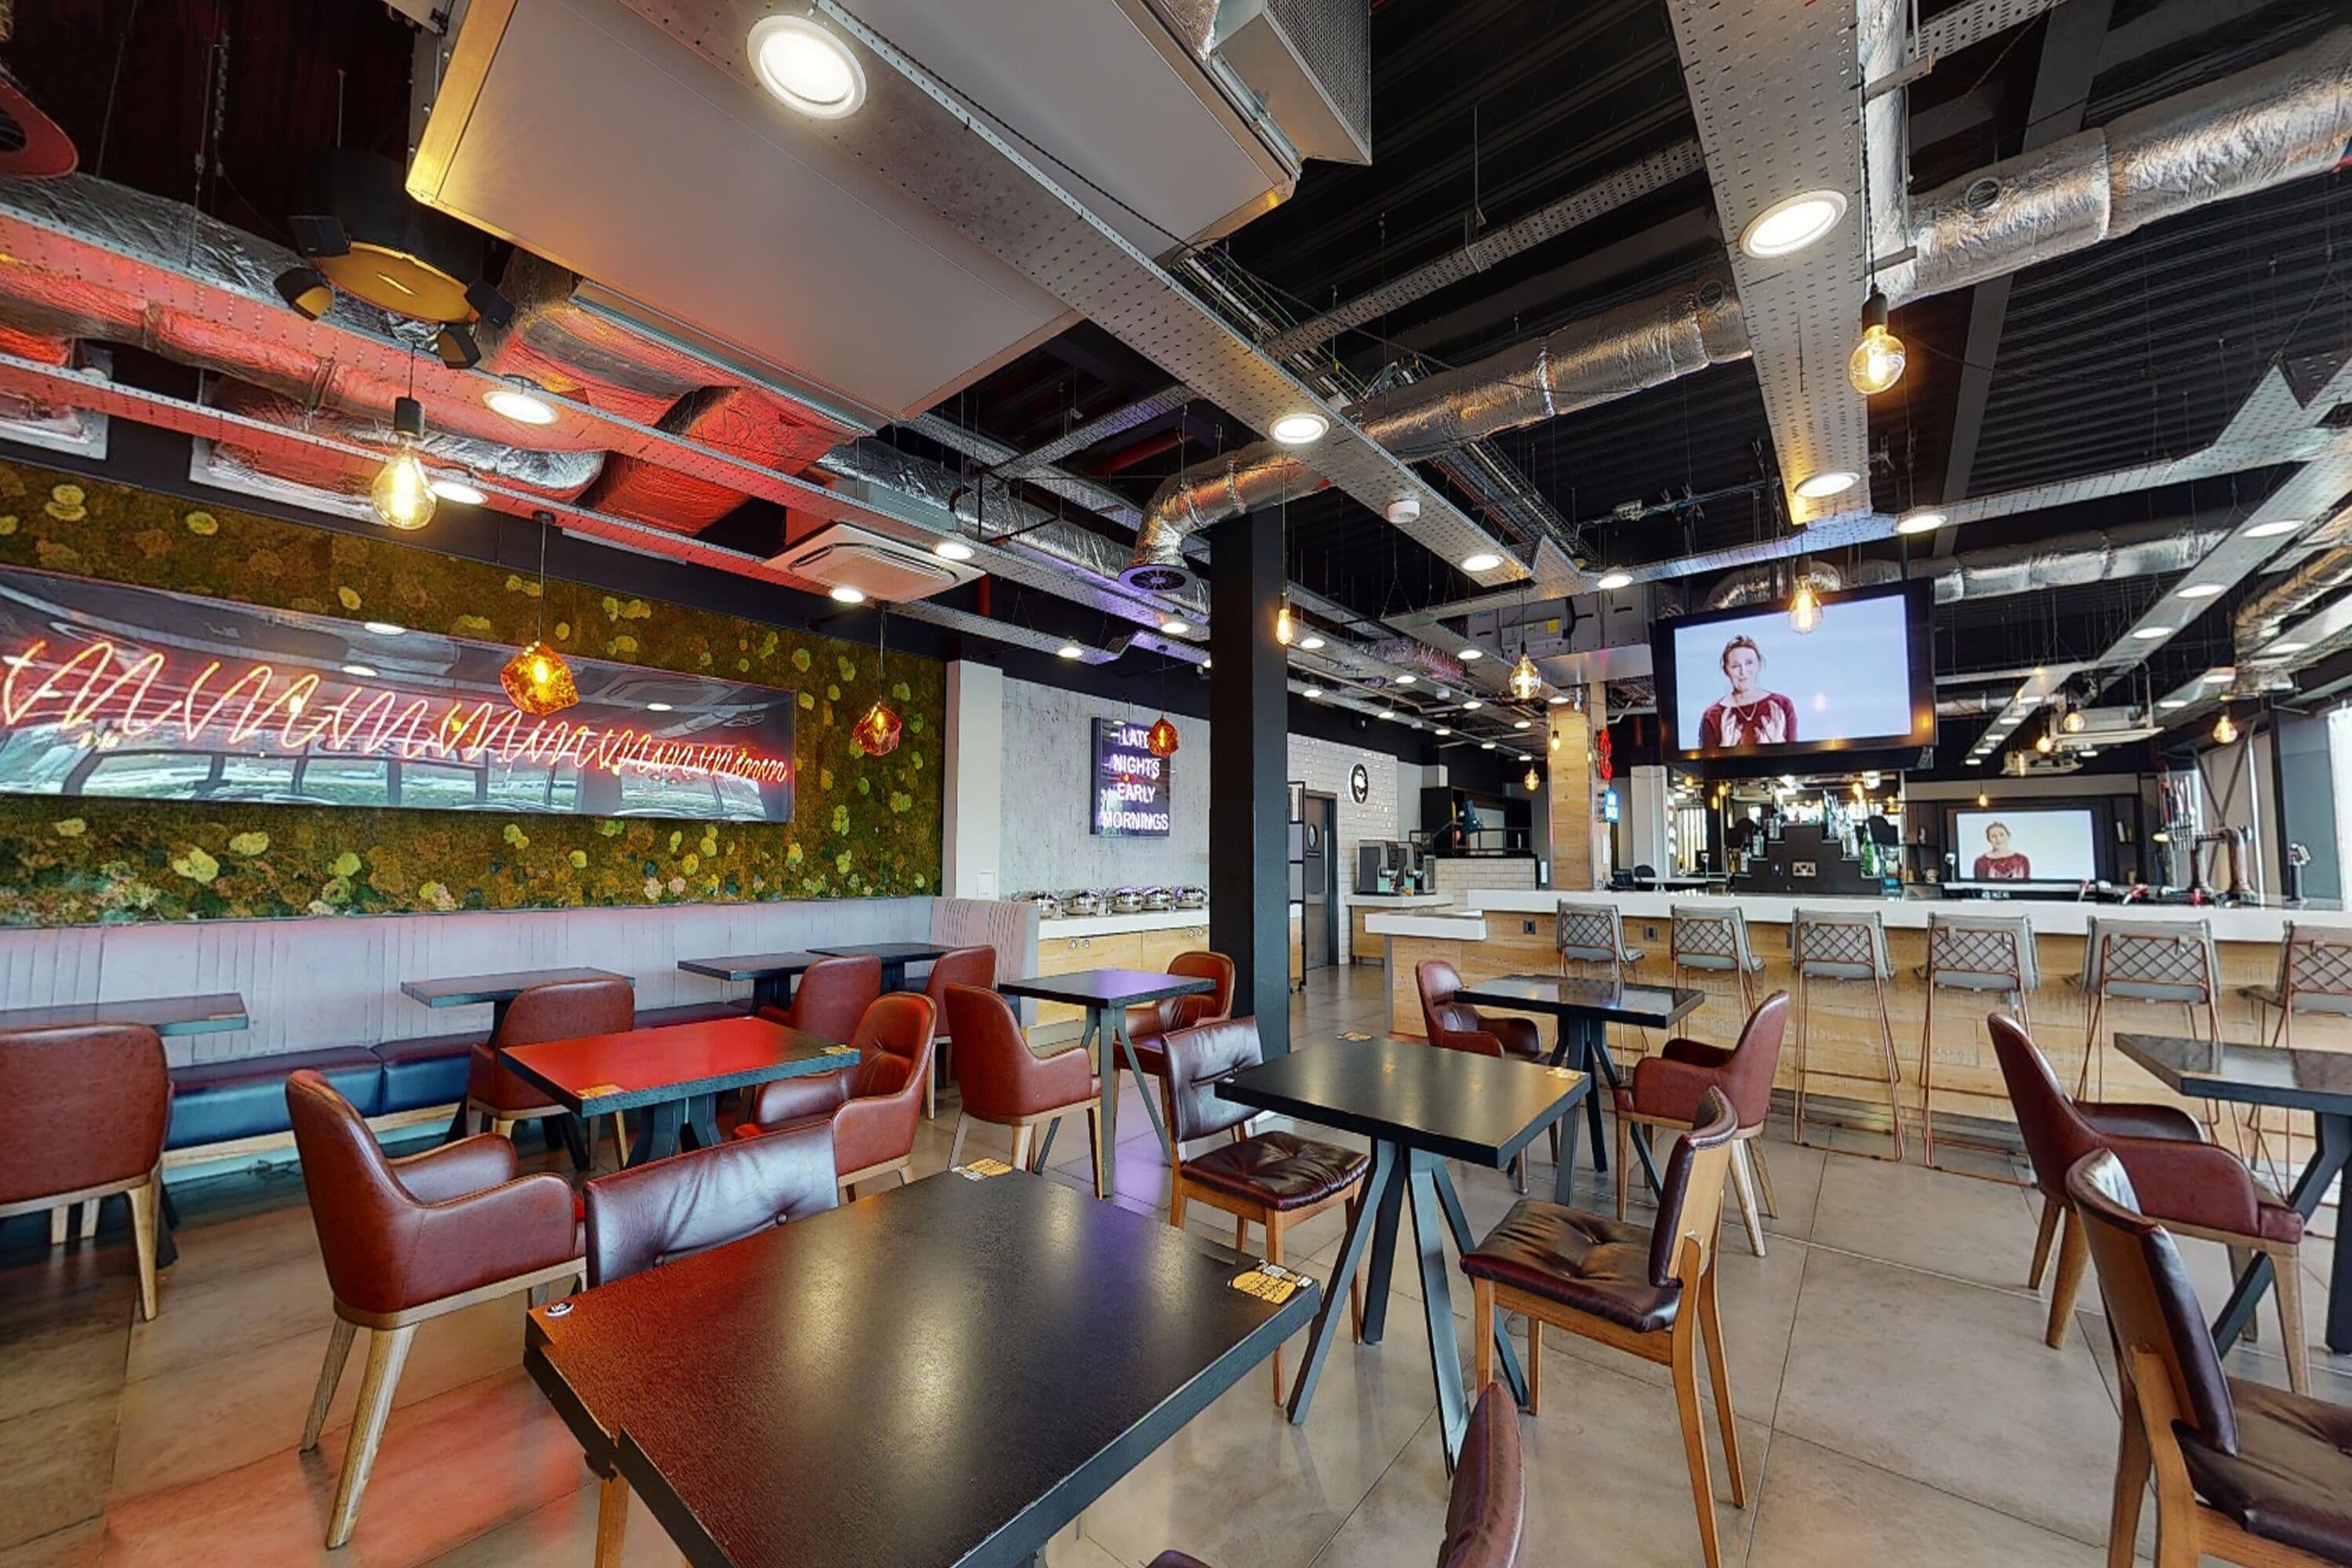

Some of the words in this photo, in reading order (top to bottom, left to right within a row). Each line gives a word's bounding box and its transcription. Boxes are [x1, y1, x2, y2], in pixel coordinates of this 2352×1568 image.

[1111, 753, 1160, 779] NIGHTS
[1116, 782, 1156, 803] EARLY
[1100, 811, 1169, 830] MORNINGS
